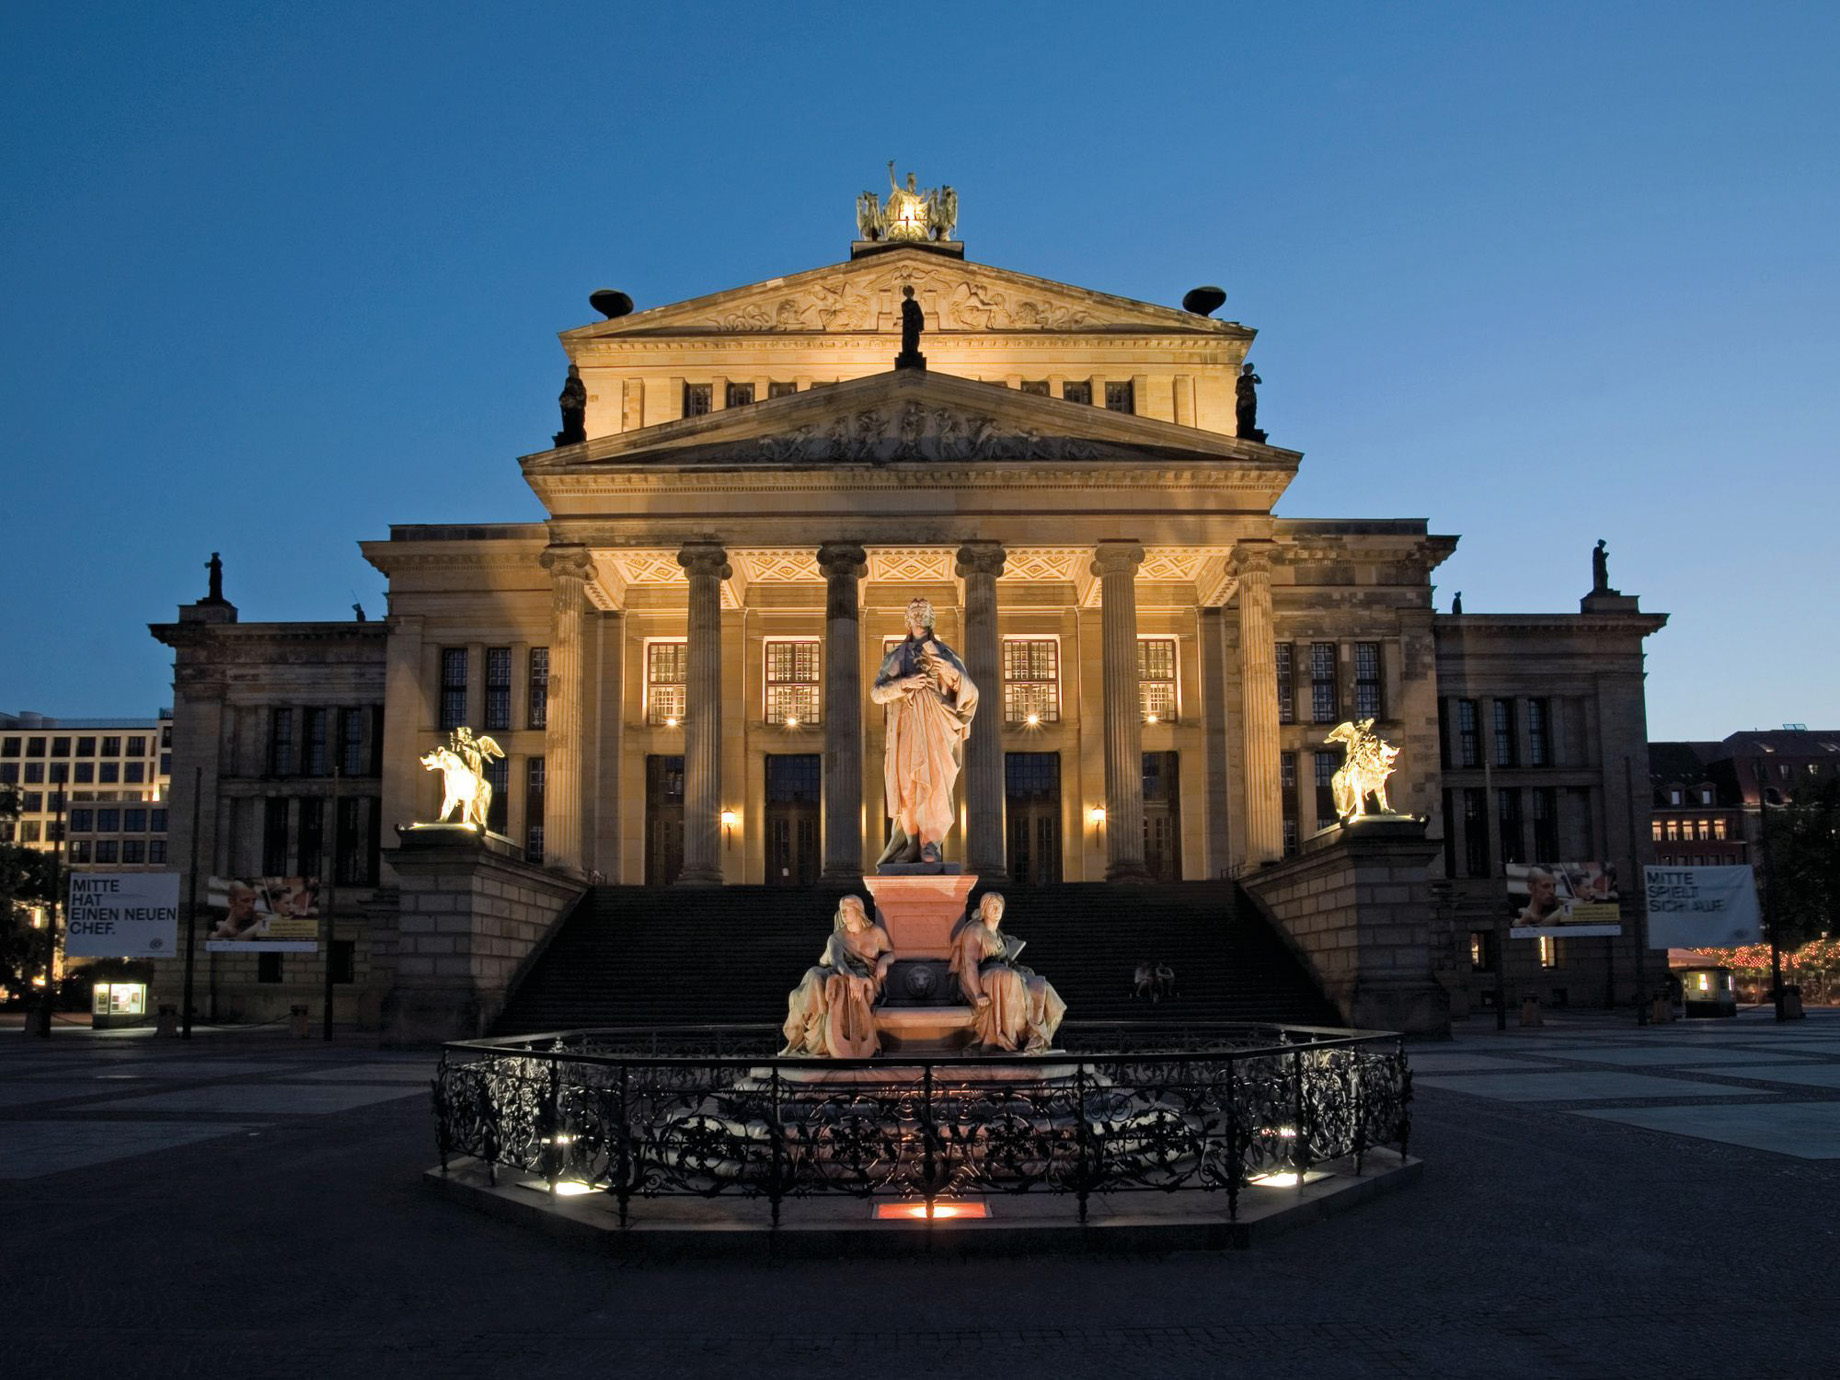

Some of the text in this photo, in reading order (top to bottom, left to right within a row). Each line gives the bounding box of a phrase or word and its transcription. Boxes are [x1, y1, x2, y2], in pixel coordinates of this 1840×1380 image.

[1647, 872, 1693, 885] MITTE
[72, 879, 120, 892] MITTE
[1648, 886, 1699, 898] SPIELT
[72, 893, 103, 906] HAT
[71, 907, 176, 920] EINEN NEUEN
[69, 921, 116, 935] CHEF.
